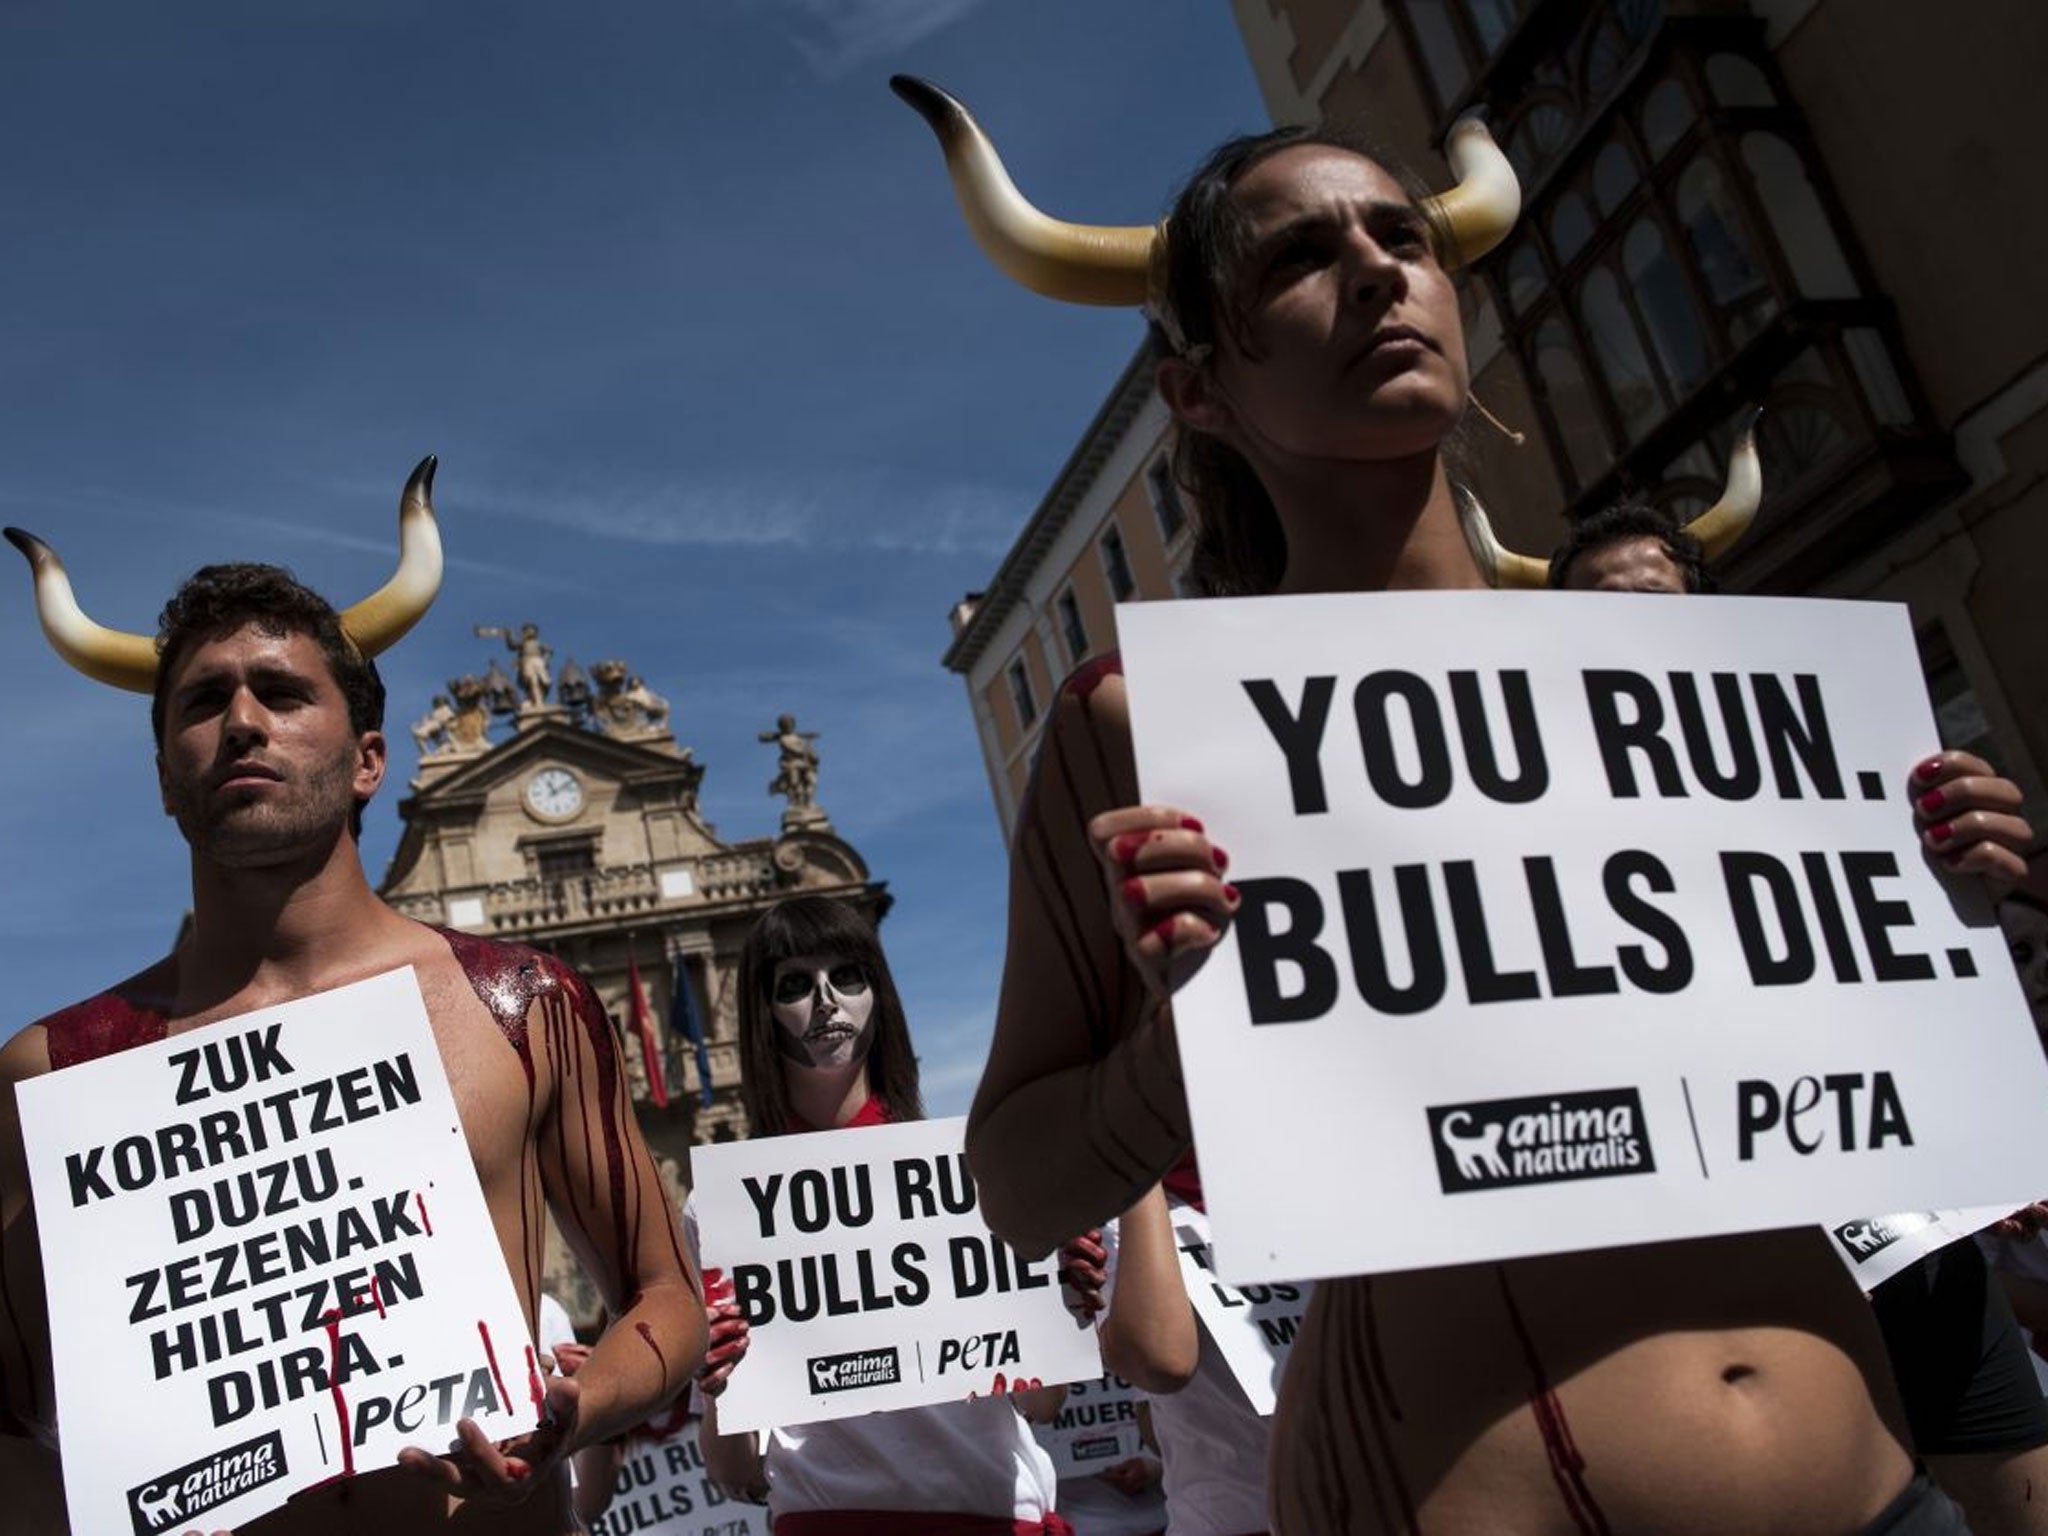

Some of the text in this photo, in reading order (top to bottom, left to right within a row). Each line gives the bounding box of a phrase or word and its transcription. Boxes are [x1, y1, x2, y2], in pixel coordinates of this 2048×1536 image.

[1241, 669, 1885, 816] YOU RUN.
[1231, 849, 1979, 1026] BULLS DIE.
[168, 1022, 295, 1106] ZUK
[65, 1052, 422, 1207] KORRITZEN
[1506, 1102, 1632, 1148] anima
[1513, 1136, 1642, 1177] naturalis
[168, 1147, 364, 1245] DUZU.
[742, 1152, 977, 1239] YOU RU
[126, 1190, 423, 1325] ZEZENAK
[733, 1242, 930, 1328] BULLS
[149, 1252, 424, 1381] HILTZEN
[206, 1331, 405, 1428] DIRA.
[839, 1353, 893, 1376] anima
[841, 1367, 896, 1388] naturalis
[1053, 1400, 1136, 1430] MUER
[184, 1440, 274, 1494] anima
[186, 1461, 278, 1515] naturalis
[614, 1455, 656, 1495] OU
